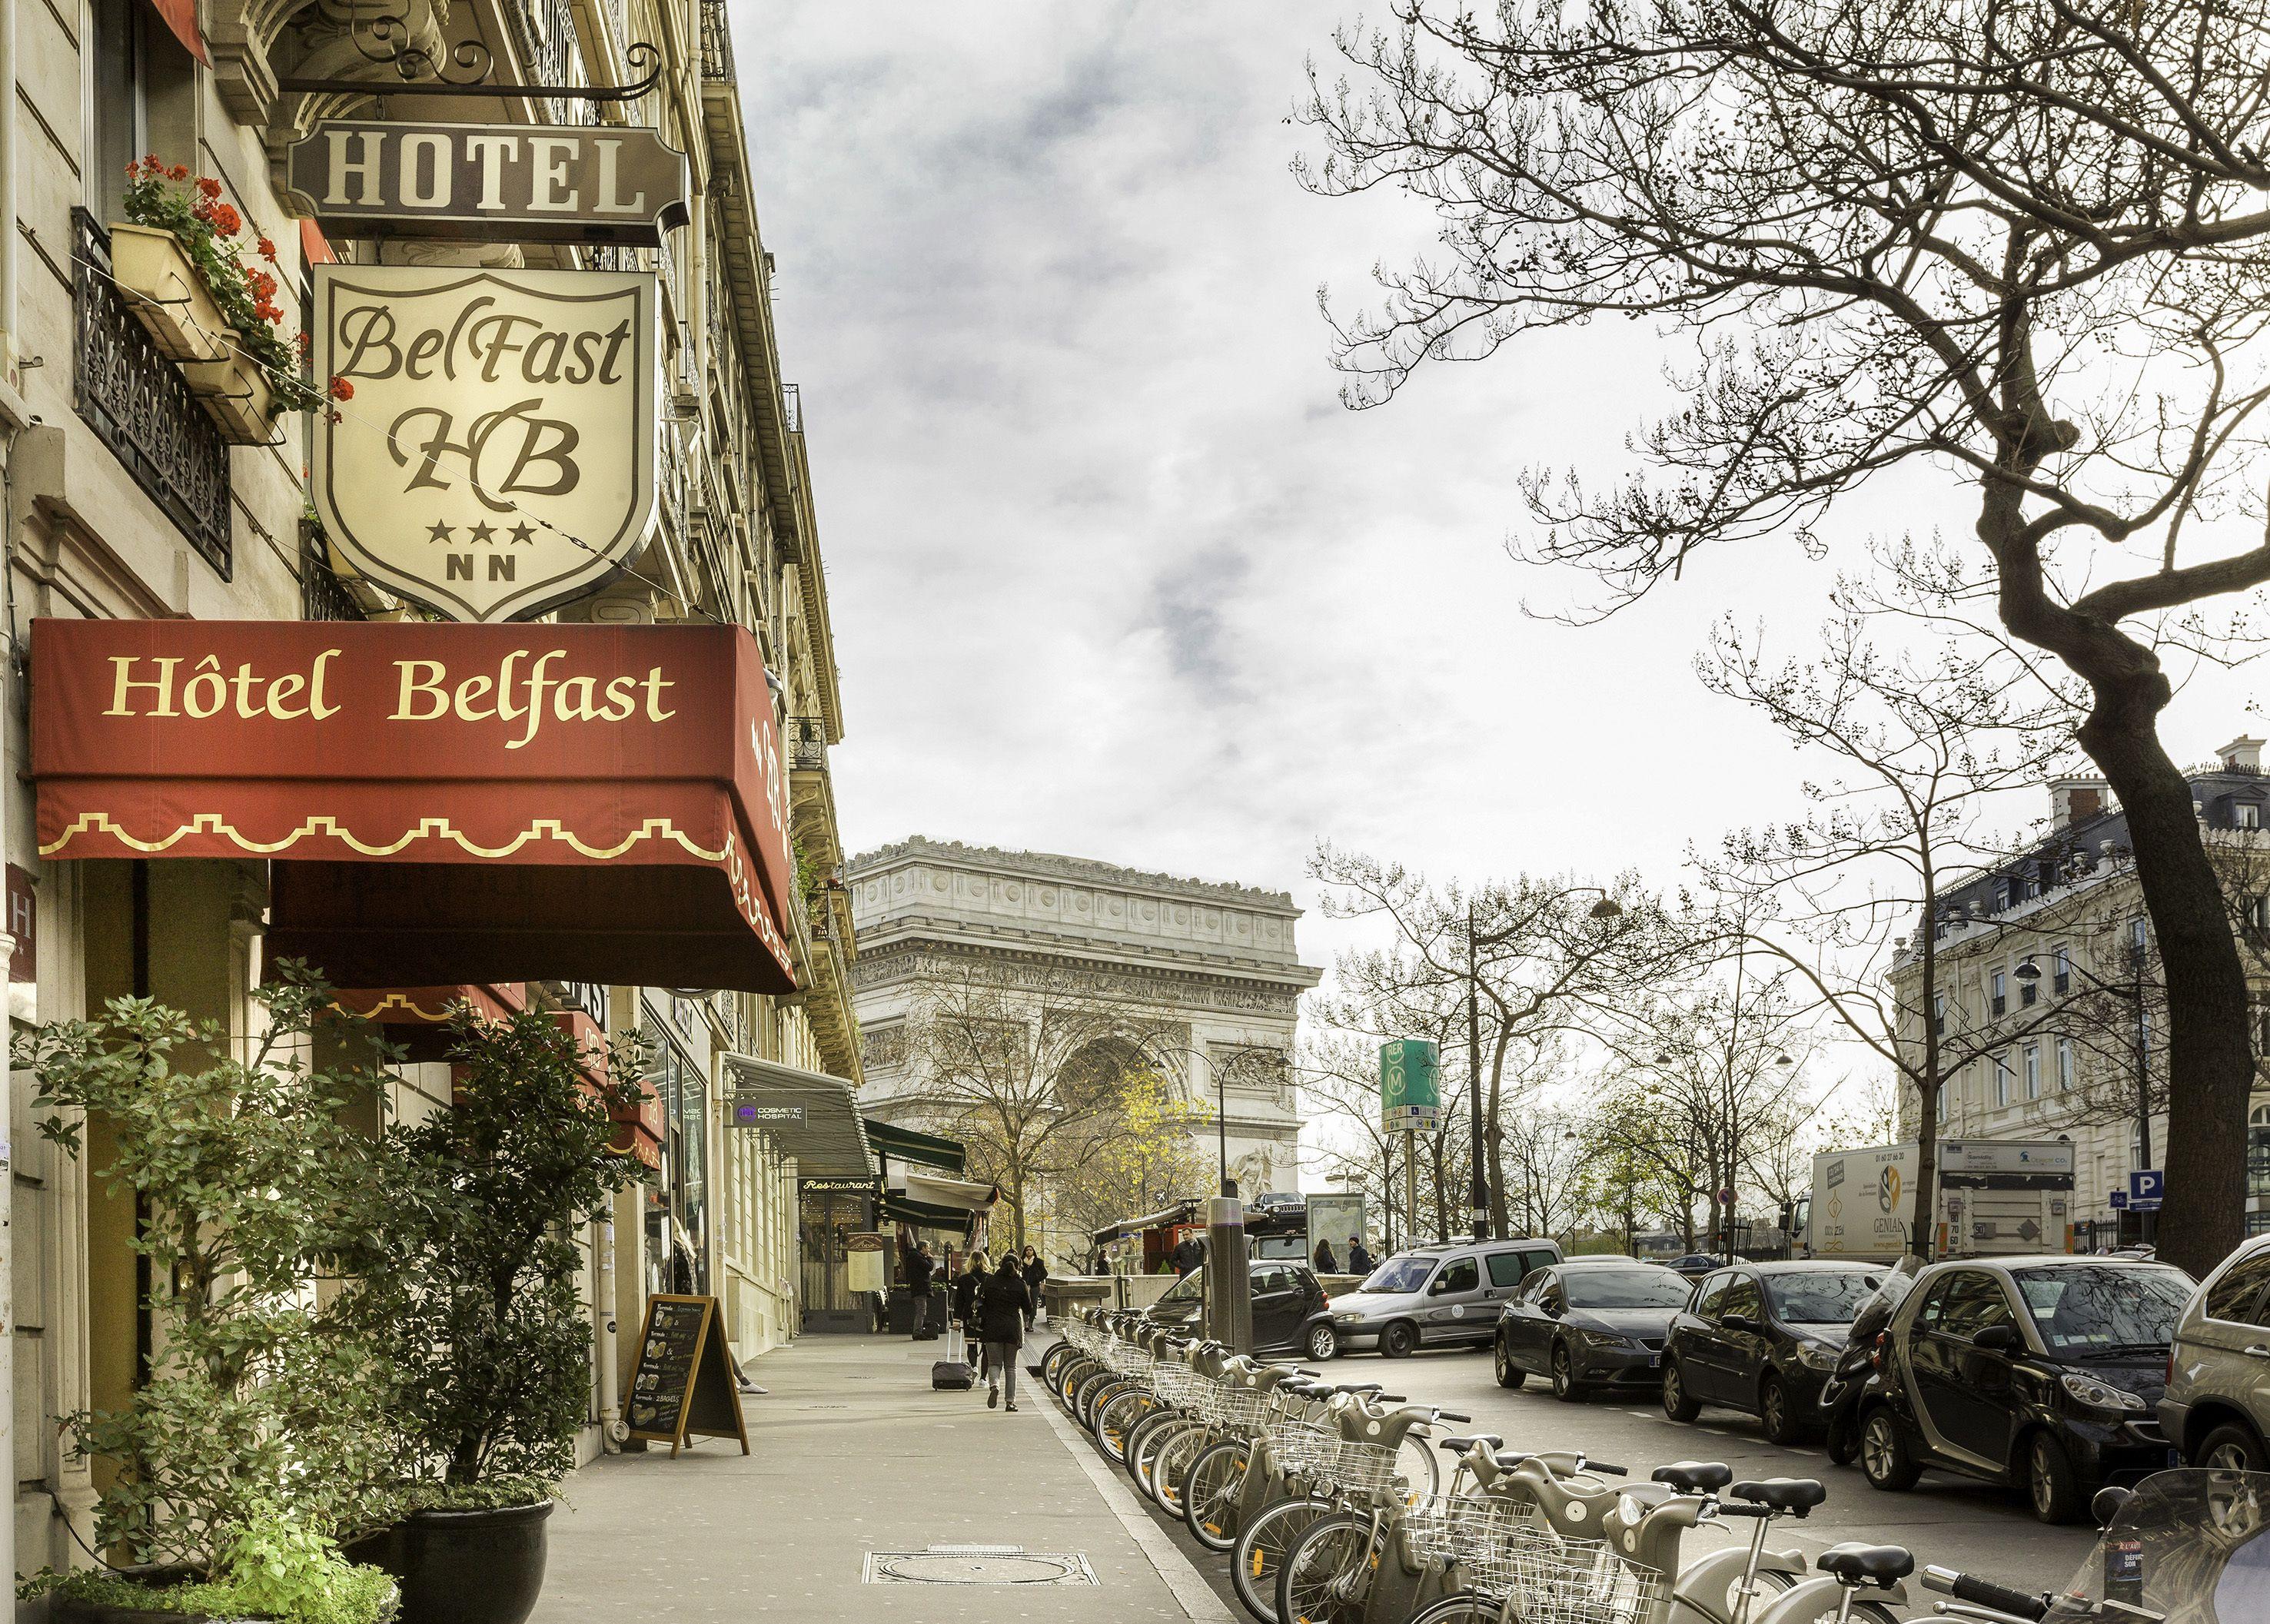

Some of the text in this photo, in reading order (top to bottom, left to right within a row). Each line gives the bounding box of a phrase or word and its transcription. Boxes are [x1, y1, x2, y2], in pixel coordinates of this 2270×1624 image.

[321, 130, 646, 214] HOTEL
[387, 397, 581, 513] HB
[101, 649, 343, 721] Hôtel
[386, 649, 677, 749] Belfast
[11, 890, 32, 939] H
[1388, 1042, 1403, 1056] RER
[803, 1181, 875, 1190] Restaurant
[2140, 1177, 2155, 1194] P
[1874, 1218, 1902, 1233] GENIAL
[1950, 1214, 1959, 1223] 80
[1951, 1225, 1959, 1234] 70
[1950, 1236, 1958, 1244] 60
